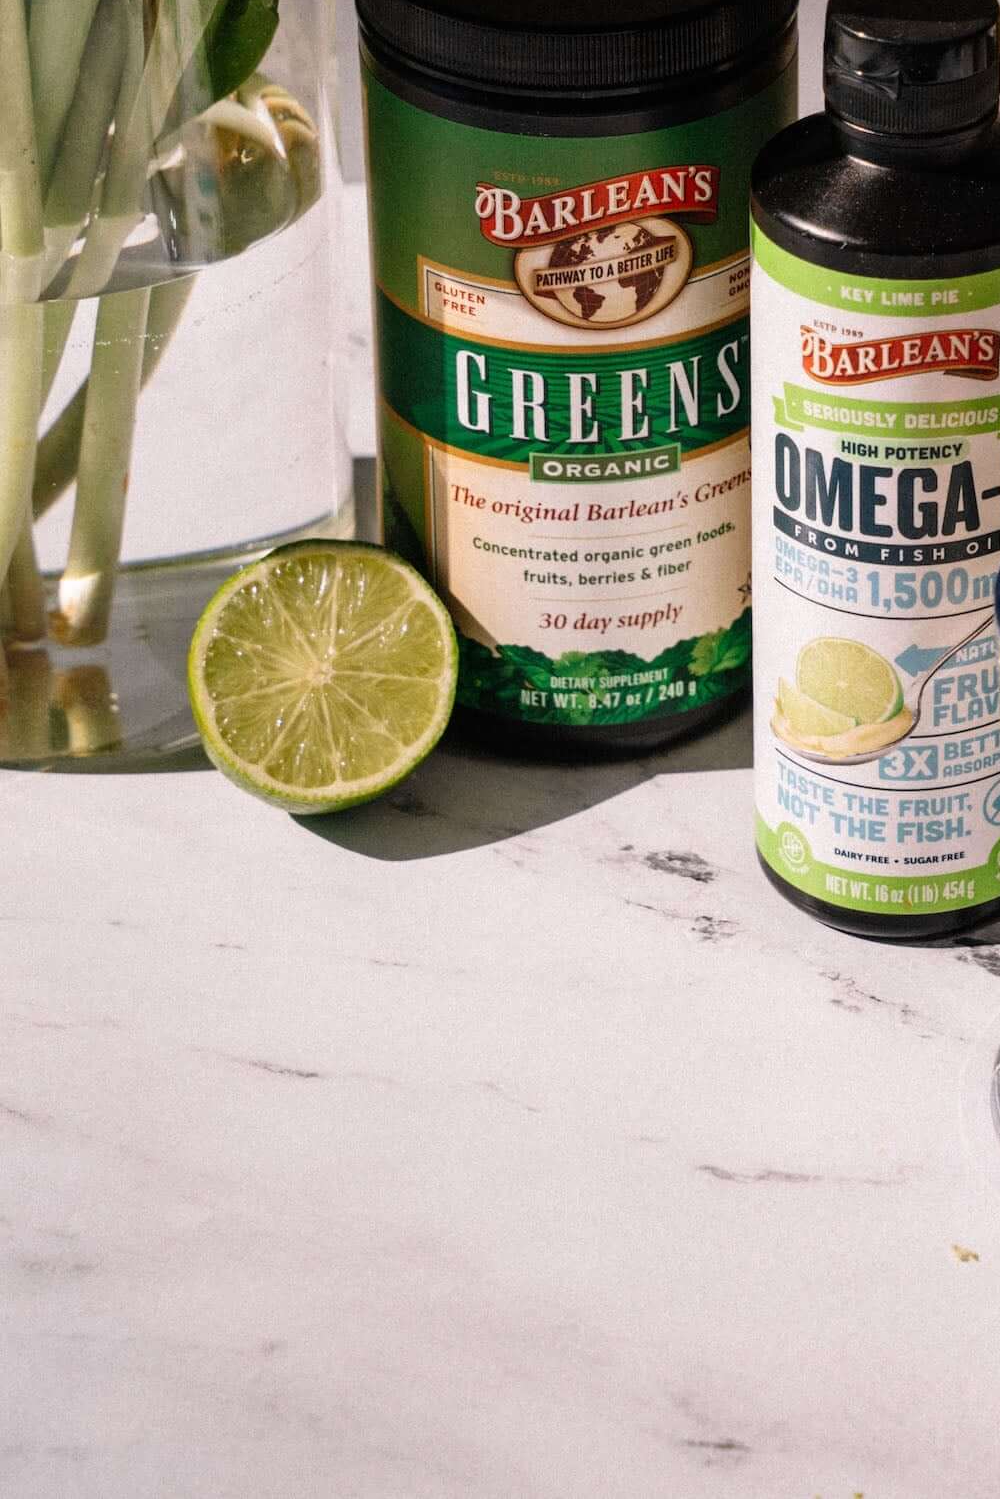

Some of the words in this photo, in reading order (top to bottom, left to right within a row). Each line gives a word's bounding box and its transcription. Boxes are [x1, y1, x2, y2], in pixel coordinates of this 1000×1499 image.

[474, 165, 714, 241] BARLEAN'S
[535, 269, 587, 287] PATHWAY
[589, 267, 604, 280] TO
[606, 264, 615, 277] A
[616, 254, 654, 274] BETTER
[655, 244, 675, 267] LIFE
[434, 281, 487, 305] GLUTEN
[442, 298, 477, 317] FREE
[840, 285, 875, 305] KEY
[881, 291, 925, 306] LIME
[931, 289, 960, 306] PIE
[812, 319, 837, 334] ESTD
[841, 327, 864, 338] 1989
[800, 330, 995, 378] BARLEAN'S
[455, 340, 742, 444] GREENS
[803, 401, 897, 429] SERIOUSLY
[904, 406, 1000, 430] DELICIOUS
[542, 454, 671, 478] ORGANIC
[841, 439, 879, 459] HIGH
[885, 442, 963, 461] POTENCY
[451, 483, 487, 510] The
[491, 498, 580, 524] original
[586, 490, 690, 522] Barlean's
[472, 536, 579, 563] Concentrated
[583, 546, 645, 565] organic
[649, 536, 693, 558] green
[696, 520, 737, 545] foods,
[794, 523, 860, 558] FROM
[881, 544, 946, 562] FISH
[523, 569, 573, 587] fruits,
[578, 568, 636, 586] berries
[641, 567, 652, 581] &
[657, 559, 693, 578] fiber
[774, 535, 859, 584] OMEGA-3
[866, 566, 999, 614] 1,500m
[537, 612, 568, 630] 30
[573, 612, 613, 635] day
[616, 602, 684, 631] supply
[520, 690, 549, 706] NET
[553, 691, 583, 709] WT.
[588, 691, 620, 709] 8.47
[625, 694, 641, 706] oz
[645, 686, 653, 704] /
[658, 681, 685, 701] 240
[687, 681, 697, 697] g
[550, 674, 596, 690] DIETARY
[599, 667, 669, 688] SUPPLEMENT
[932, 665, 1000, 706] FRU
[932, 691, 1000, 727] FLAV
[882, 747, 937, 778] 3X
[777, 760, 836, 807] TASTE
[842, 791, 890, 818] THE
[776, 784, 821, 826] NOT
[828, 810, 887, 843] THE
[896, 816, 973, 844] FISH.
[834, 847, 864, 861] DAIRY
[865, 853, 890, 864] FREE
[903, 854, 940, 865] SUGAR
[941, 850, 966, 861] FREE
[825, 873, 848, 896] NET
[850, 880, 872, 902] WT.
[875, 883, 889, 903] 16
[890, 889, 904, 903] oz
[942, 879, 965, 901] 454
[967, 880, 975, 901] g
